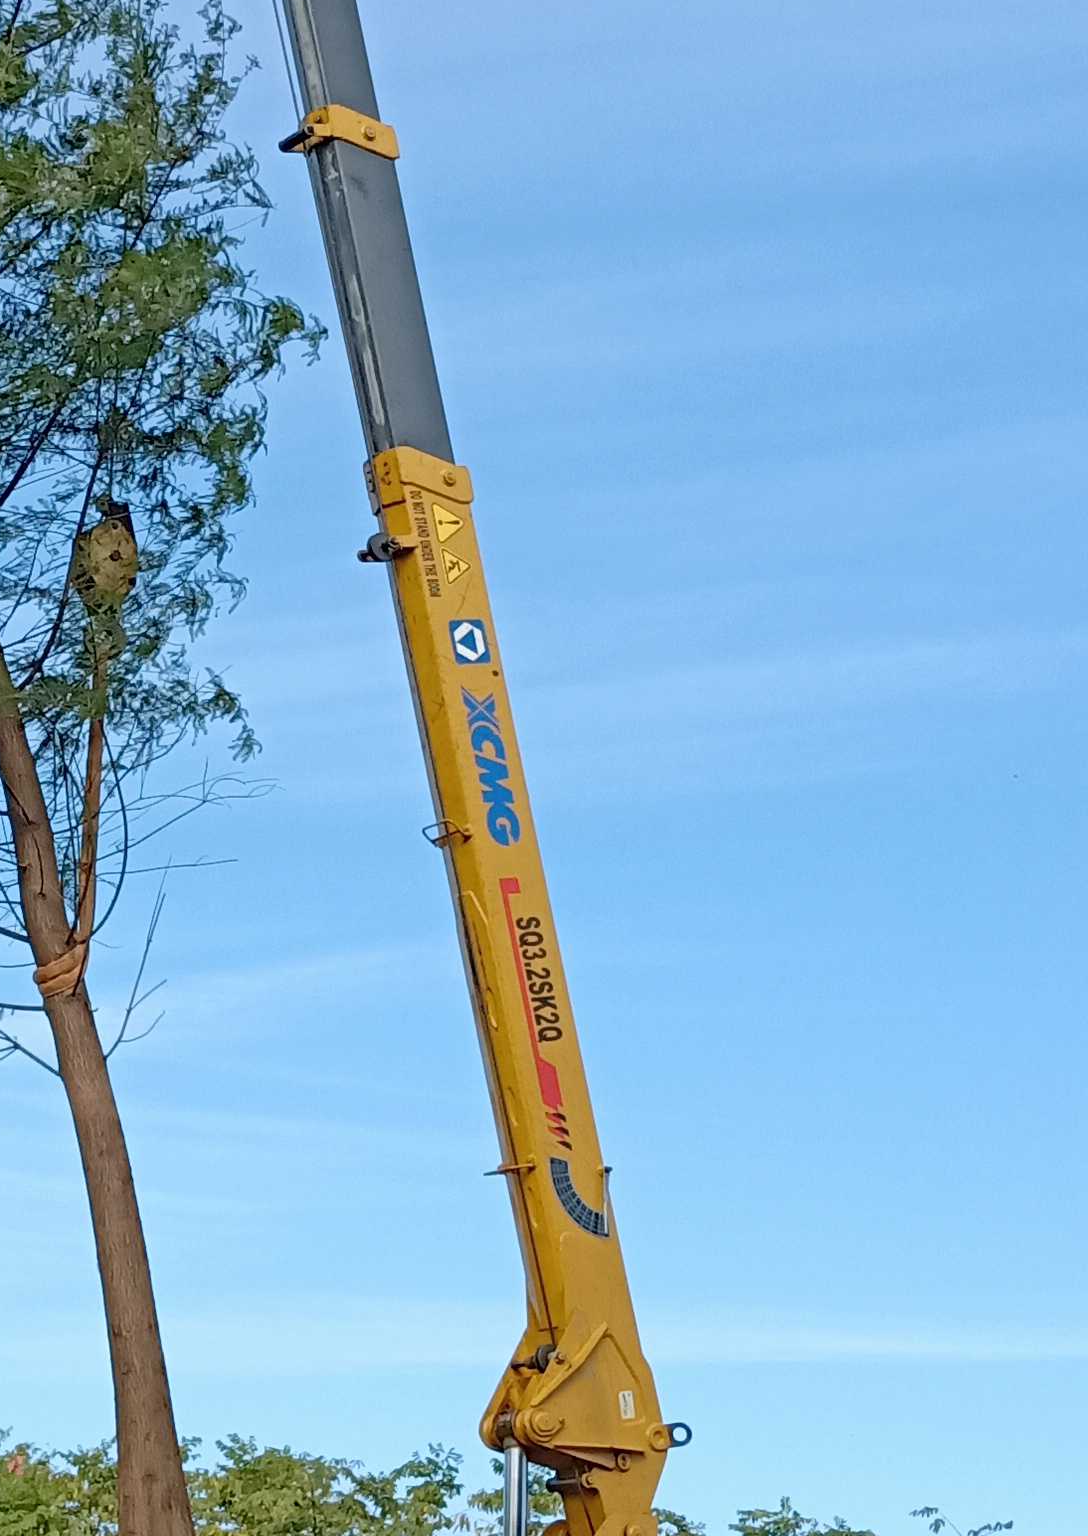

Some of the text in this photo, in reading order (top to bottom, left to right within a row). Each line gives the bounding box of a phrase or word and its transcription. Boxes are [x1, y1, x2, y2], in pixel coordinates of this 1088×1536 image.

[409, 490, 442, 598] DO NOT STAND UNDER THE BOOM
[461, 685, 521, 847] XCMG
[515, 916, 563, 1043] SQ3.2SK2Q
